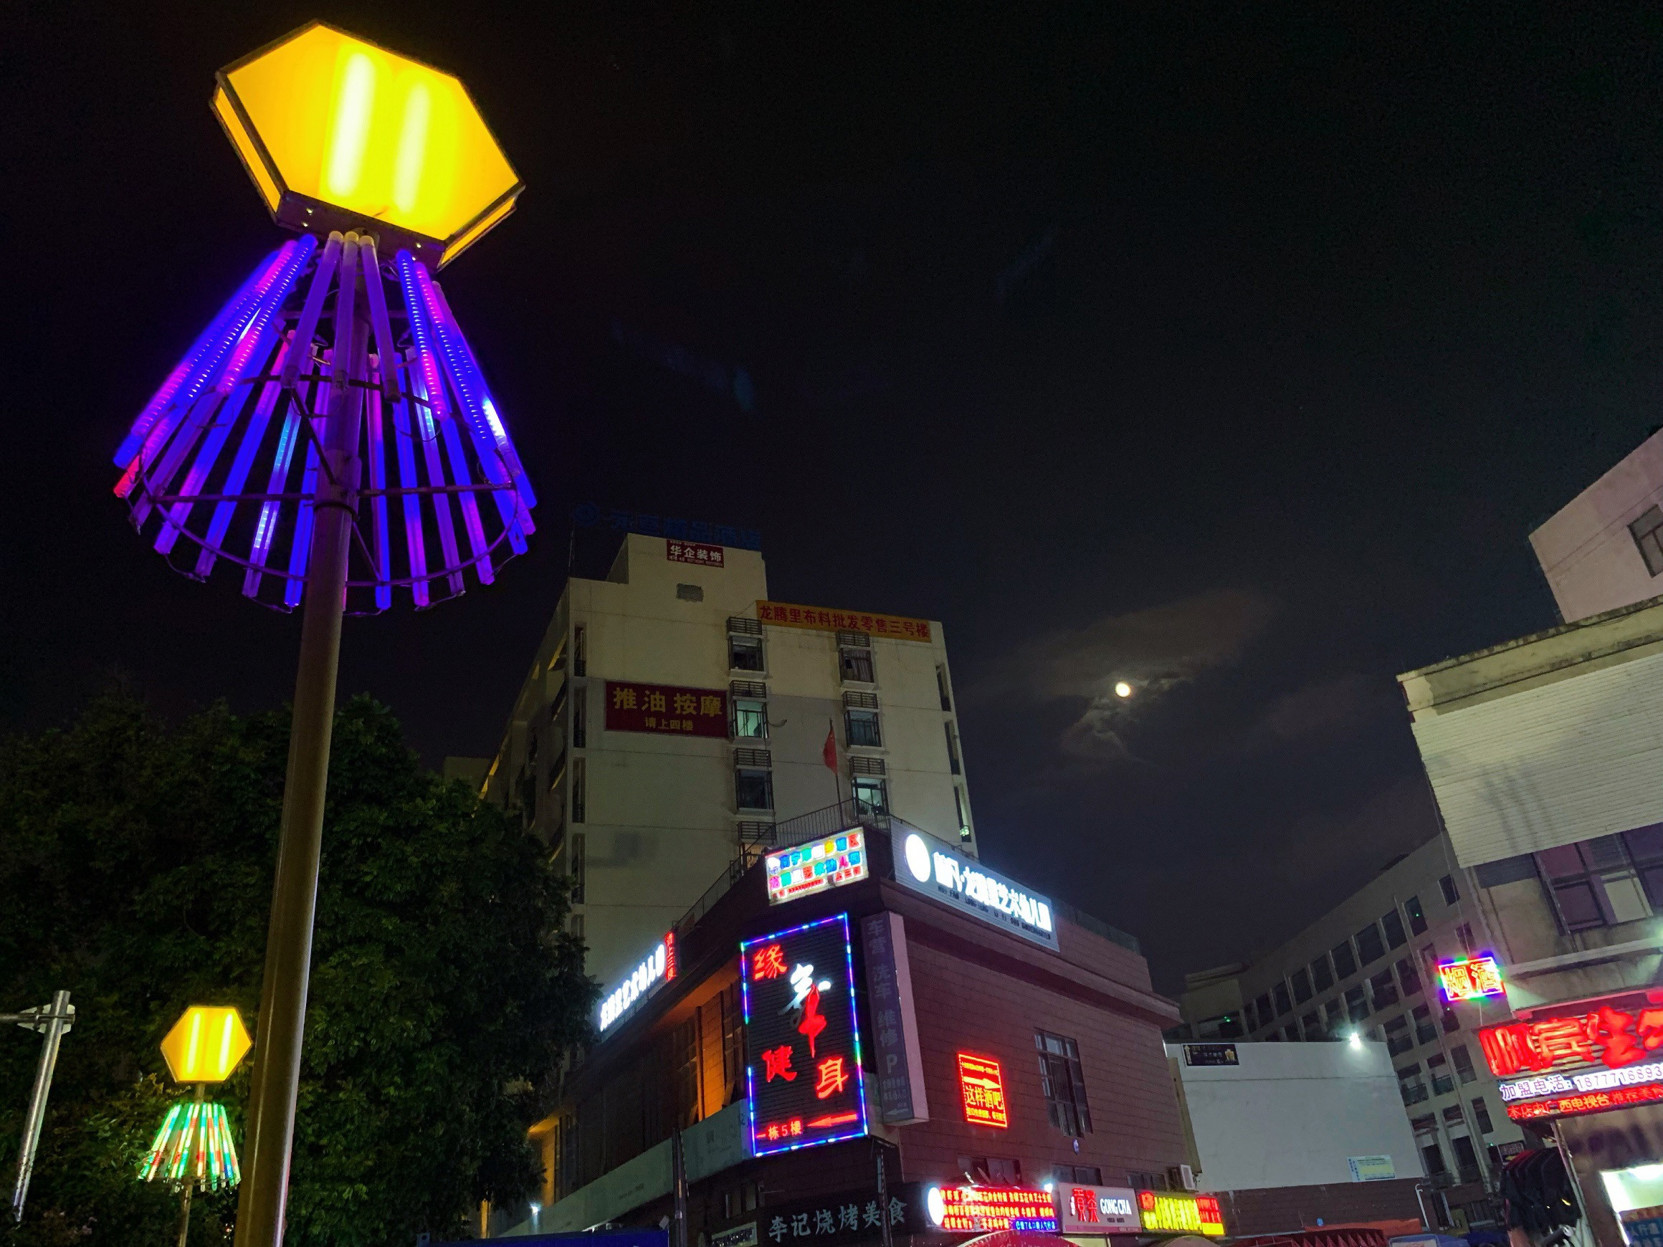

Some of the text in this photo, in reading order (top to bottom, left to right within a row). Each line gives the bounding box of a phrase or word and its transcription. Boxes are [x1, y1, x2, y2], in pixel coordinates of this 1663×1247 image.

[670, 545, 722, 562] 华企装饰
[760, 606, 928, 638] 龙腾里布料批发零售三号楼
[613, 687, 722, 717] 推油按摩
[645, 717, 694, 731] 请上四楼
[752, 944, 788, 981] 缘
[1445, 962, 1498, 997] 烟酒
[762, 1045, 849, 1099] 健身
[965, 1085, 1003, 1110] 这样酒吧
[768, 1196, 908, 1243] 李记烧烤美食
[1072, 1187, 1100, 1222] 贡茶
